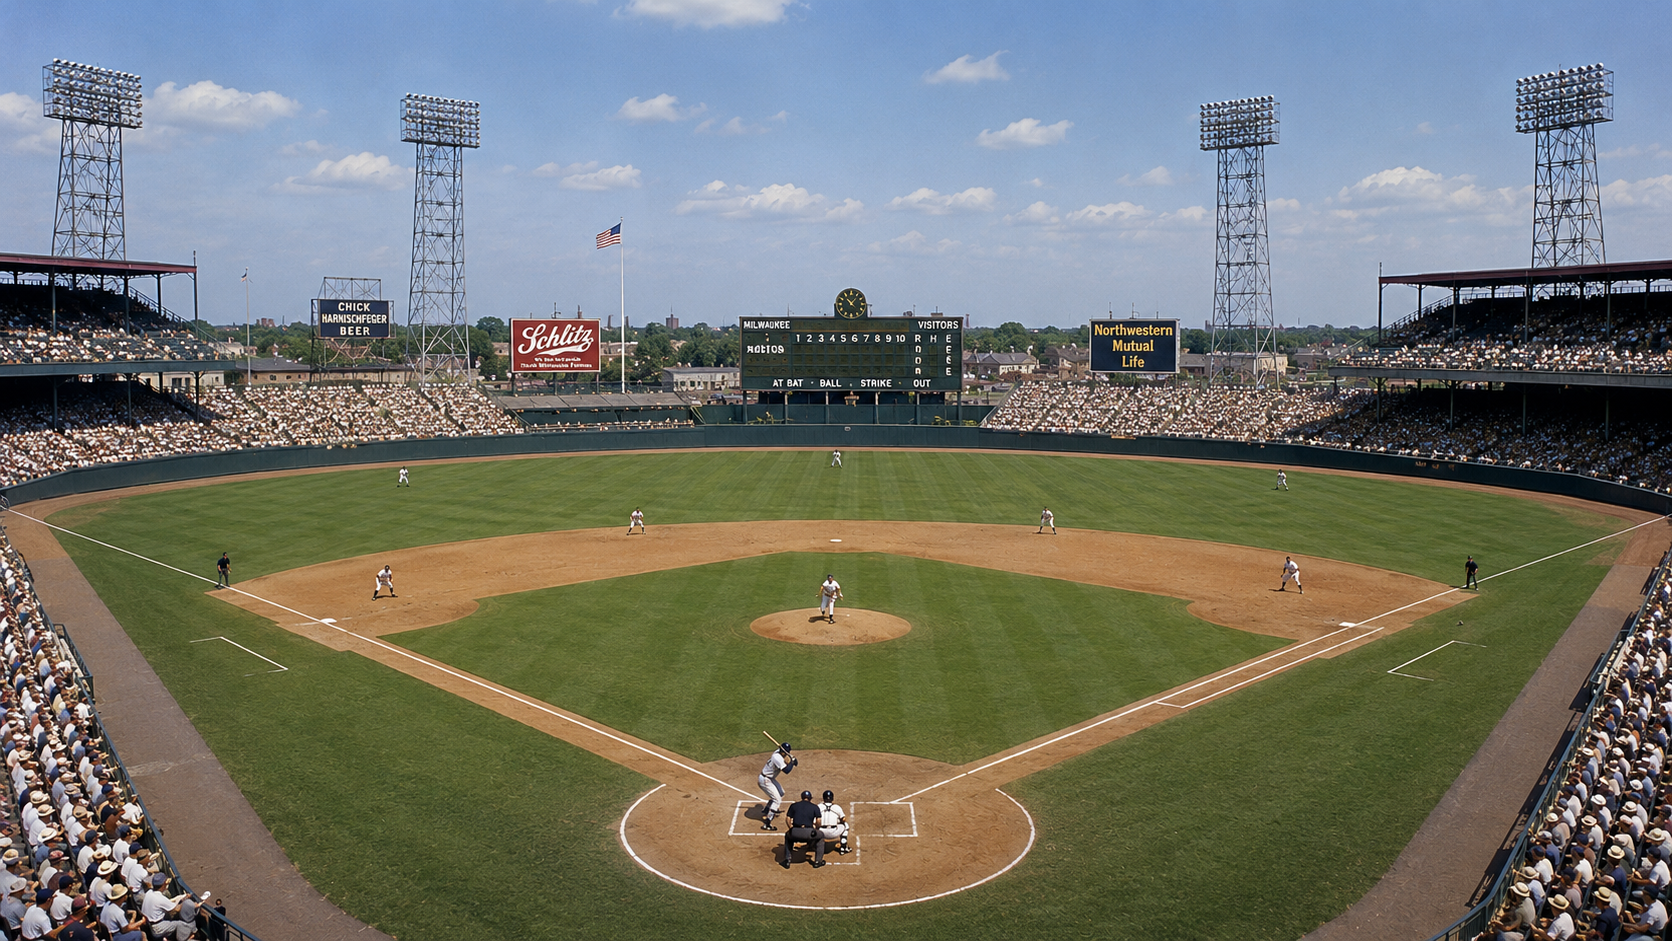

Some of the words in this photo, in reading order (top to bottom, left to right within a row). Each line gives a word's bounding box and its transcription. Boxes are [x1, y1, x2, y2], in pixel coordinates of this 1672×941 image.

[338, 302, 370, 312] CHICK
[918, 320, 958, 329] VISITORS
[340, 326, 370, 336] BEER
[1094, 324, 1173, 336] Northwestern
[518, 324, 594, 354] Schlitz
[806, 334, 812, 342] 2
[818, 334, 824, 342] 3
[829, 334, 835, 342] 4
[840, 334, 847, 342] 5
[852, 334, 858, 342] 6
[863, 334, 869, 342] 7
[875, 334, 880, 342] 8
[886, 334, 892, 342] 9
[896, 334, 905, 342] 10
[915, 334, 921, 342] R
[930, 335, 937, 343] H
[946, 334, 951, 342] E
[946, 346, 952, 354] E
[1112, 340, 1154, 352] Mutual
[1122, 355, 1145, 367] Life
[773, 379, 784, 387] AT
[787, 379, 803, 387] BAT
[820, 379, 842, 387] BALL
[861, 379, 892, 387] STRIKE
[913, 379, 931, 387] OUT
